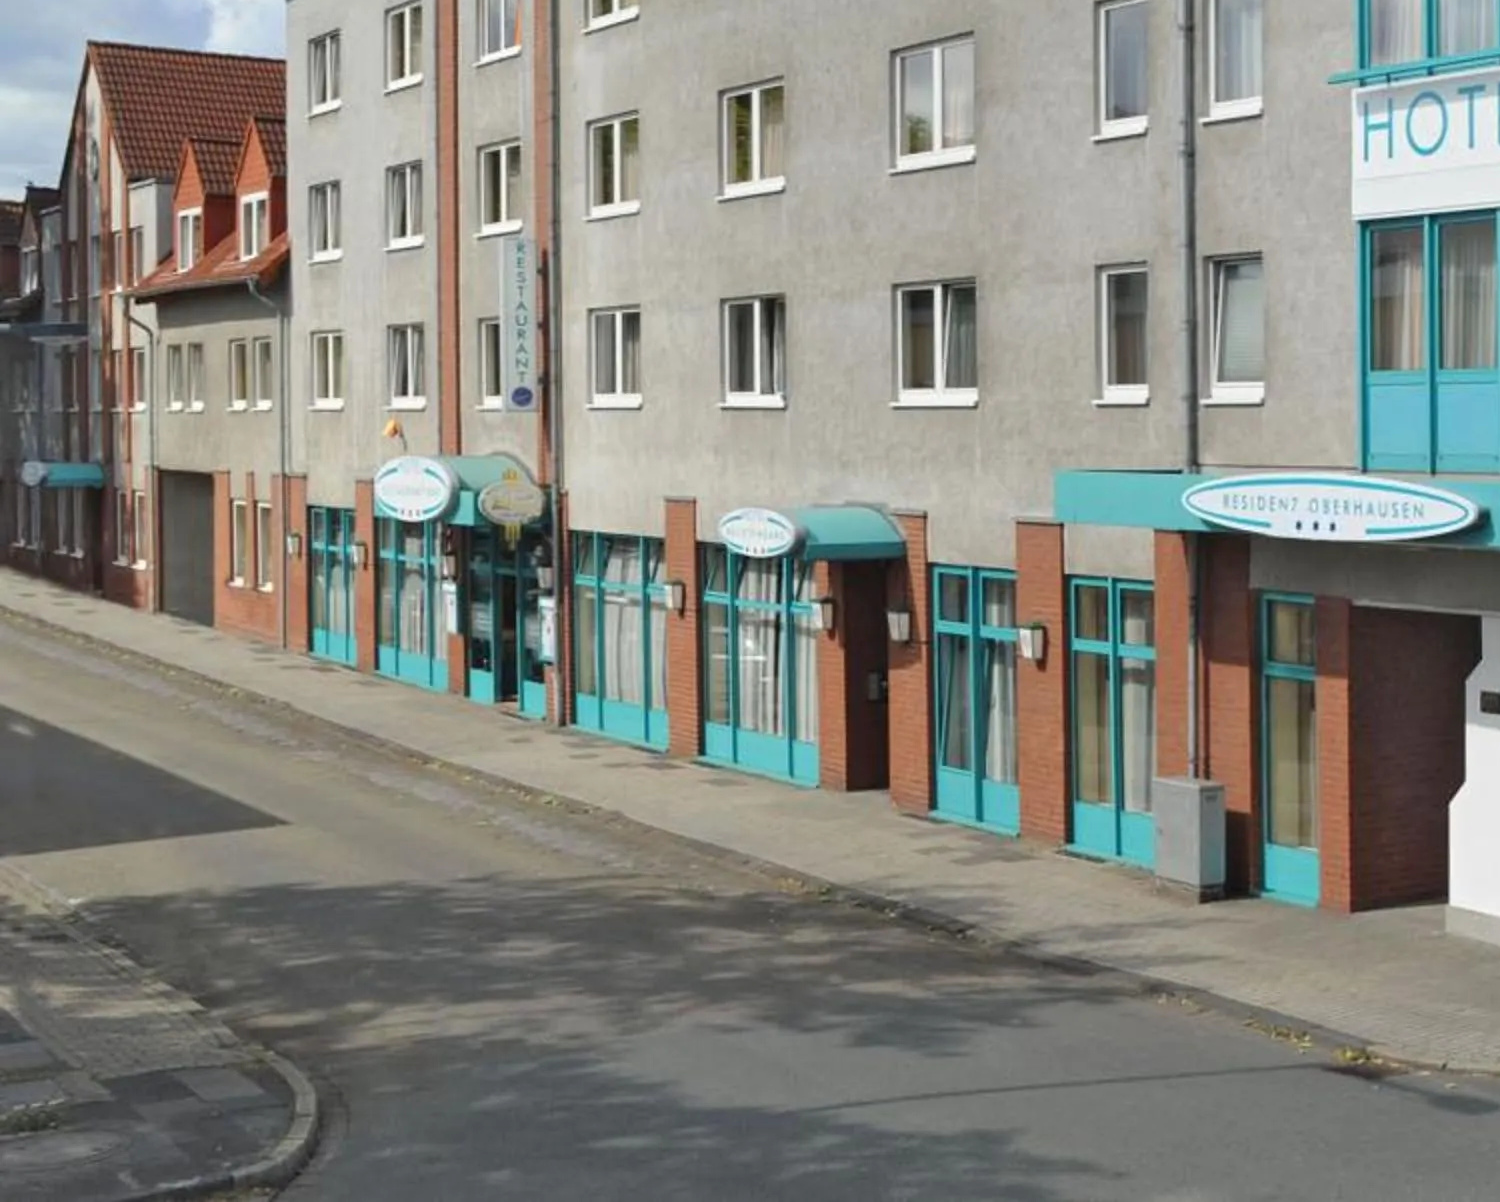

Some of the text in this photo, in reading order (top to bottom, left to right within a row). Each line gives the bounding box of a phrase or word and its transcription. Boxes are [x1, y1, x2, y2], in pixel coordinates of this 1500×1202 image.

[515, 240, 529, 383] RESTAURANT
[1223, 494, 1425, 518] RESIDENZ OBERHAUSEN
